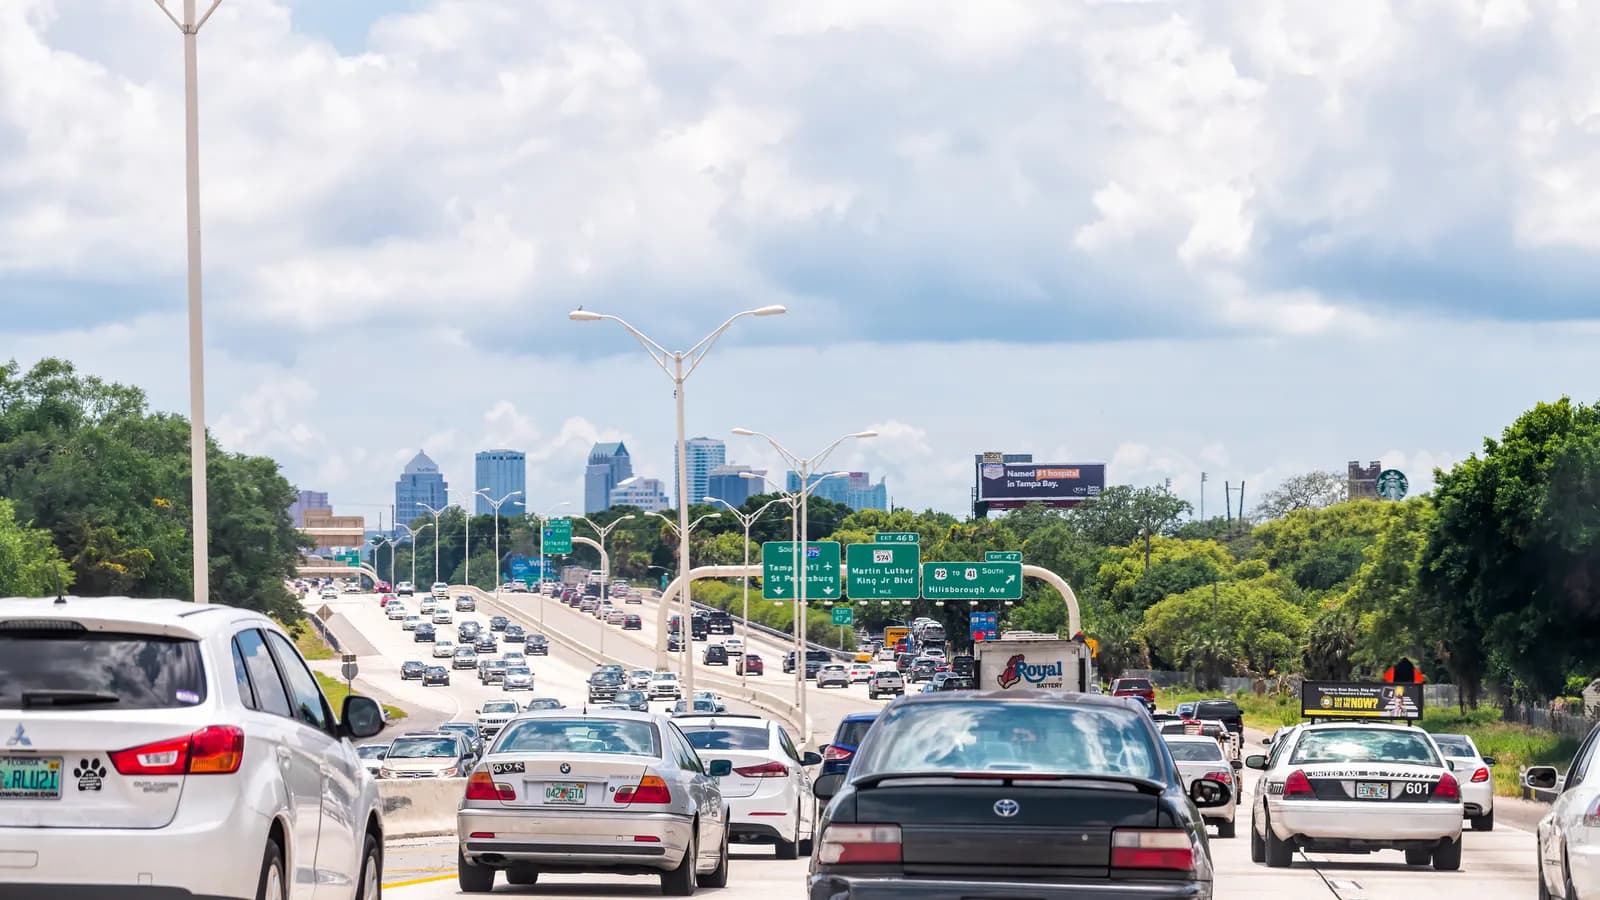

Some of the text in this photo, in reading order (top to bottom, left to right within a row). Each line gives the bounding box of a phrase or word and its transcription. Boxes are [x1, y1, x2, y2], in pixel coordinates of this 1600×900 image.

[1007, 469, 1035, 477] Named
[1037, 469, 1047, 477] #1
[1048, 469, 1080, 479] hospital
[1016, 480, 1041, 488] Tampa
[1043, 480, 1059, 489] Bay.
[769, 564, 794, 572] Tamp
[852, 567, 914, 575] Martin Luther
[935, 570, 946, 578] 92
[967, 569, 976, 578] 41
[770, 575, 780, 583] St
[856, 577, 877, 585] King
[894, 576, 914, 584] Blvd
[928, 586, 985, 595] Hillsborough
[1015, 661, 1063, 683] Royal
[1350, 697, 1379, 709] NOW?
[1405, 782, 1430, 795] 601
